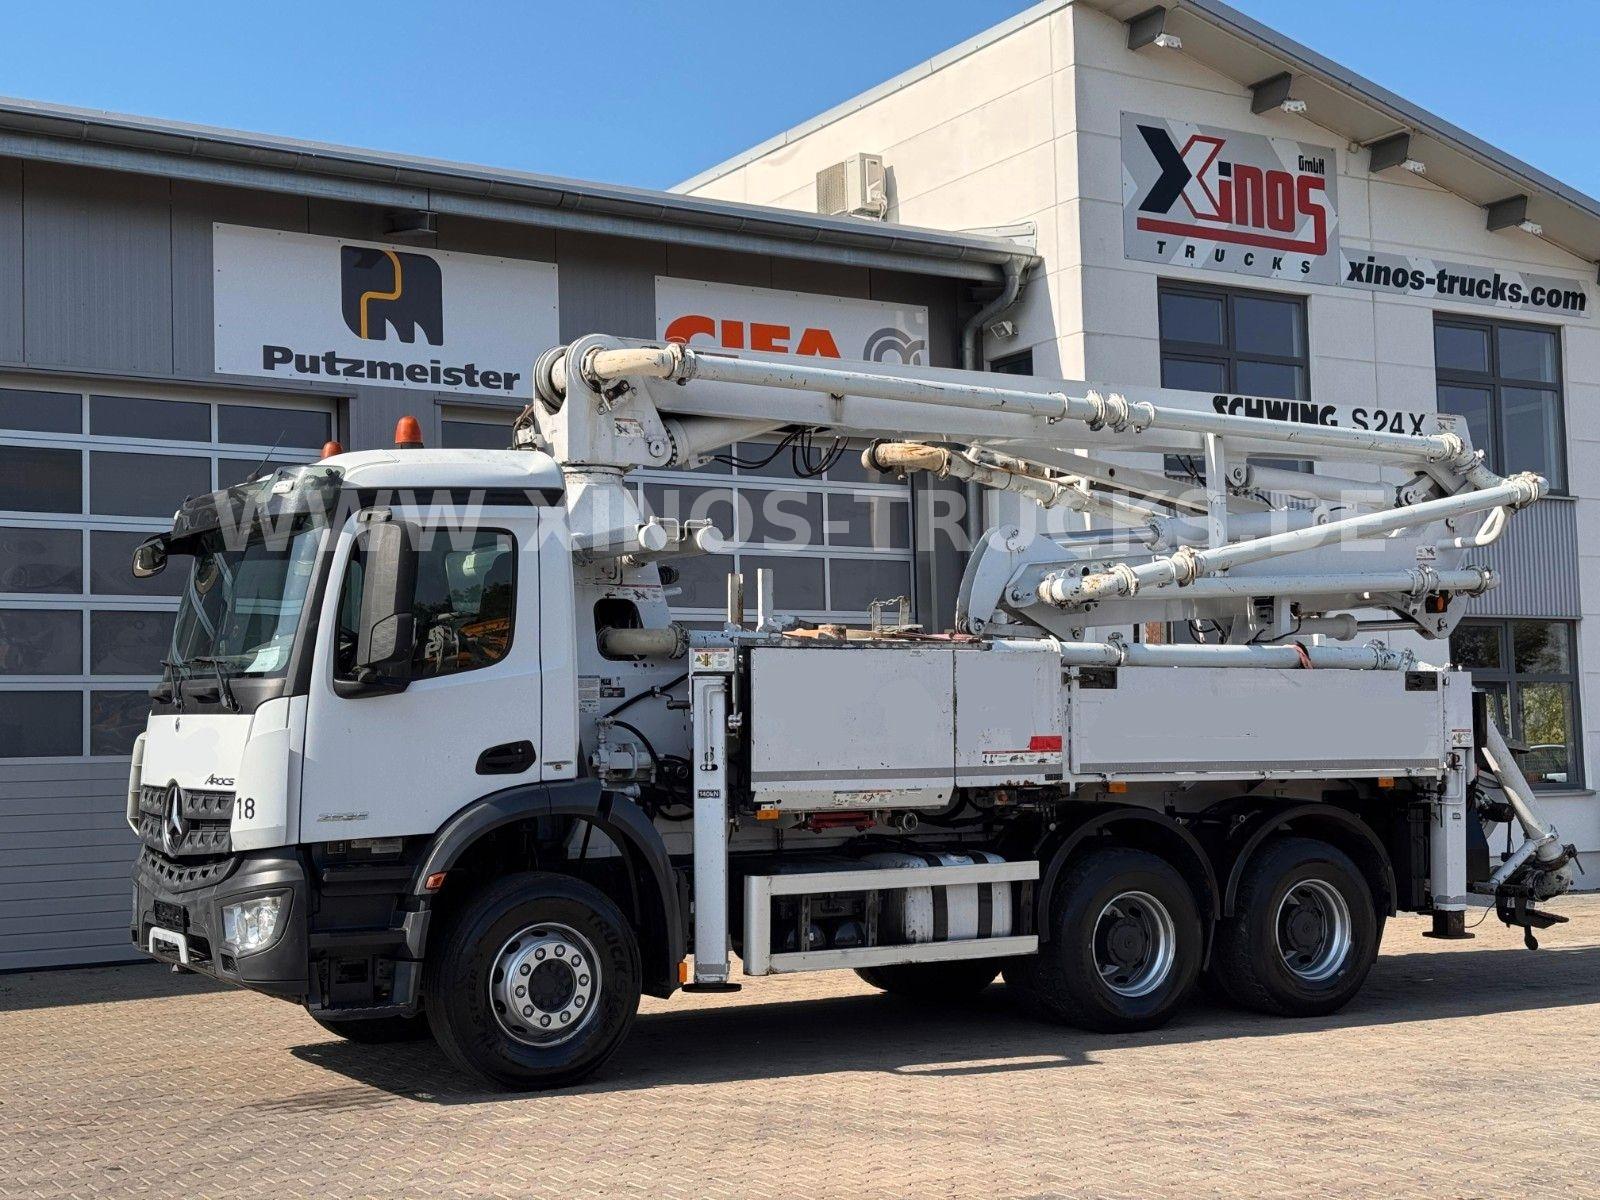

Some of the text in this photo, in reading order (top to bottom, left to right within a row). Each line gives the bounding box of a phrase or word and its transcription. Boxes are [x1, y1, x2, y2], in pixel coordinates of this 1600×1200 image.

[1298, 155, 1325, 175] GmbH
[1157, 241, 1311, 274] TRUCKS
[1346, 256, 1587, 311] xinos-trucks.com
[262, 345, 521, 390] Putzmeister
[1213, 395, 1338, 426] SCHWING
[236, 797, 255, 820] 18
